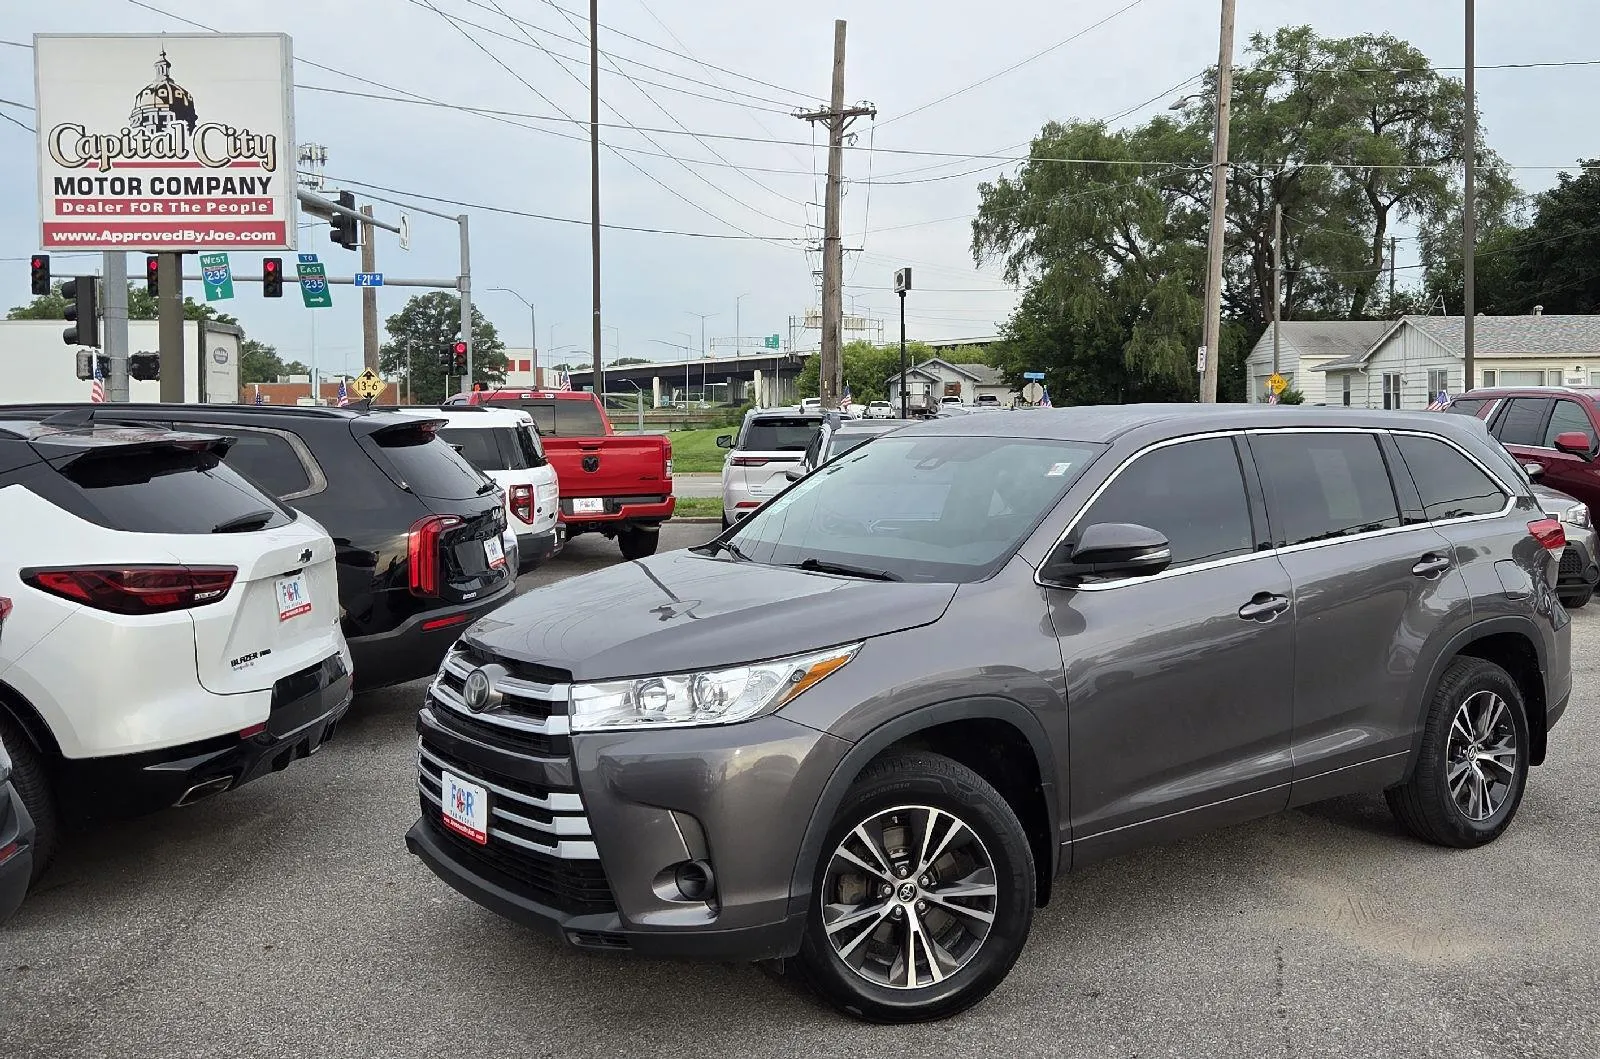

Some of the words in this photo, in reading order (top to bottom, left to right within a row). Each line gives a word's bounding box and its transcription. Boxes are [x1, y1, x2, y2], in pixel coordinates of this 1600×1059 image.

[49, 122, 189, 172] Capital
[193, 122, 277, 172] City
[54, 176, 142, 196] MOTOR
[150, 176, 272, 195] COMPANY
[62, 202, 123, 213] Dealer
[130, 202, 163, 213] FOR
[169, 202, 201, 213] The
[206, 201, 268, 214] People
[52, 229, 276, 243] www.ApprovedByJoe.com
[202, 256, 225, 264] WEST
[207, 269, 227, 281] 235
[300, 265, 321, 273] EAST
[304, 279, 324, 289] 235
[357, 380, 380, 391] 13'-6"
[231, 651, 258, 667] BLAZER
[451, 783, 475, 819] FOR
